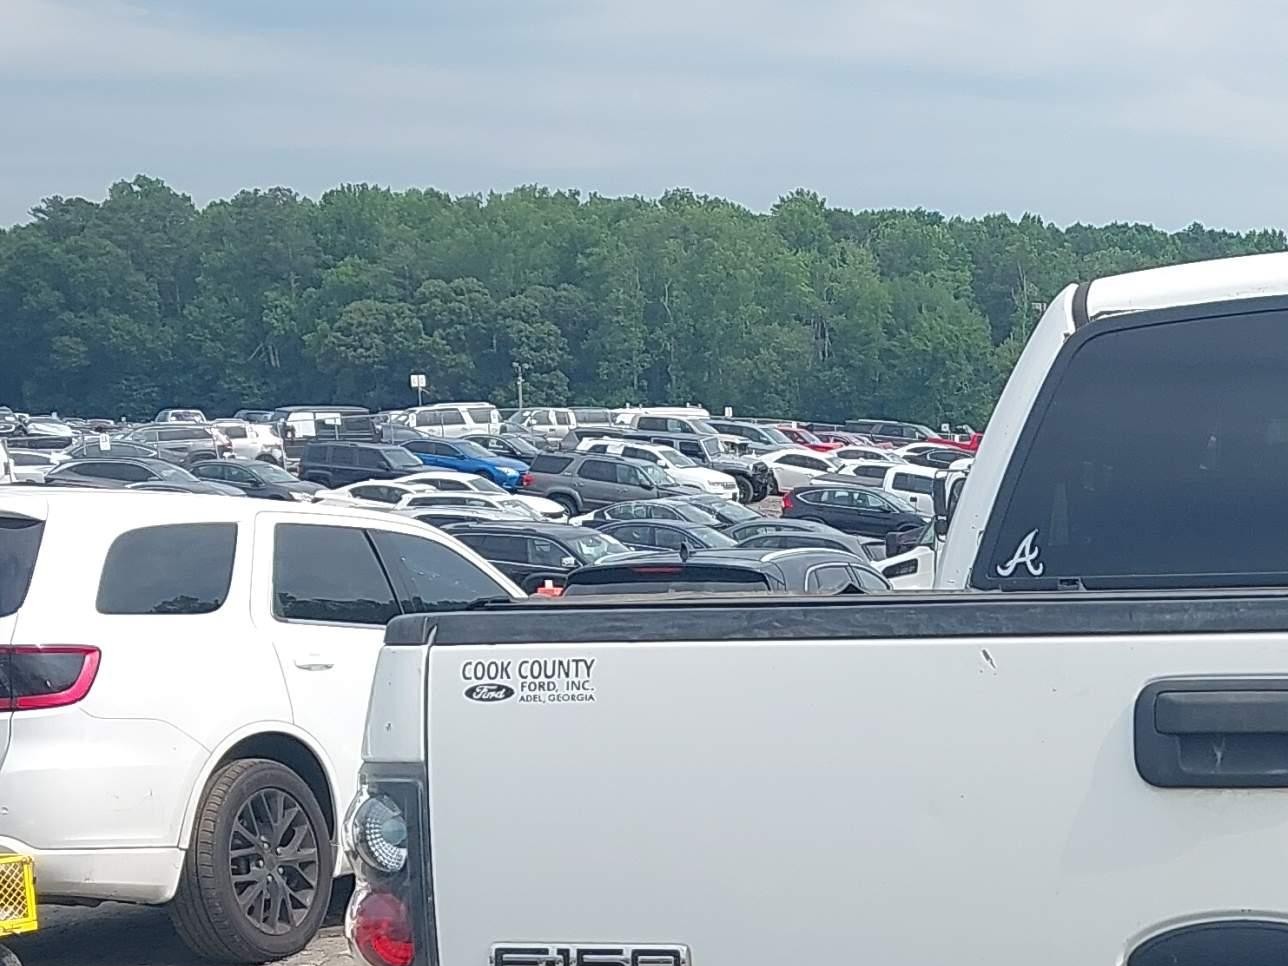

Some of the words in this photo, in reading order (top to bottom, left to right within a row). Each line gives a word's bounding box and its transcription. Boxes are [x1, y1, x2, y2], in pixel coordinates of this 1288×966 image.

[462, 661, 511, 680] COOK
[518, 659, 595, 679] COUNTY
[520, 681, 559, 692] FORD,
[566, 680, 594, 691] INC.
[473, 686, 505, 699] Ford
[519, 695, 546, 703] ADEL,
[548, 693, 595, 702] GEORGIA
